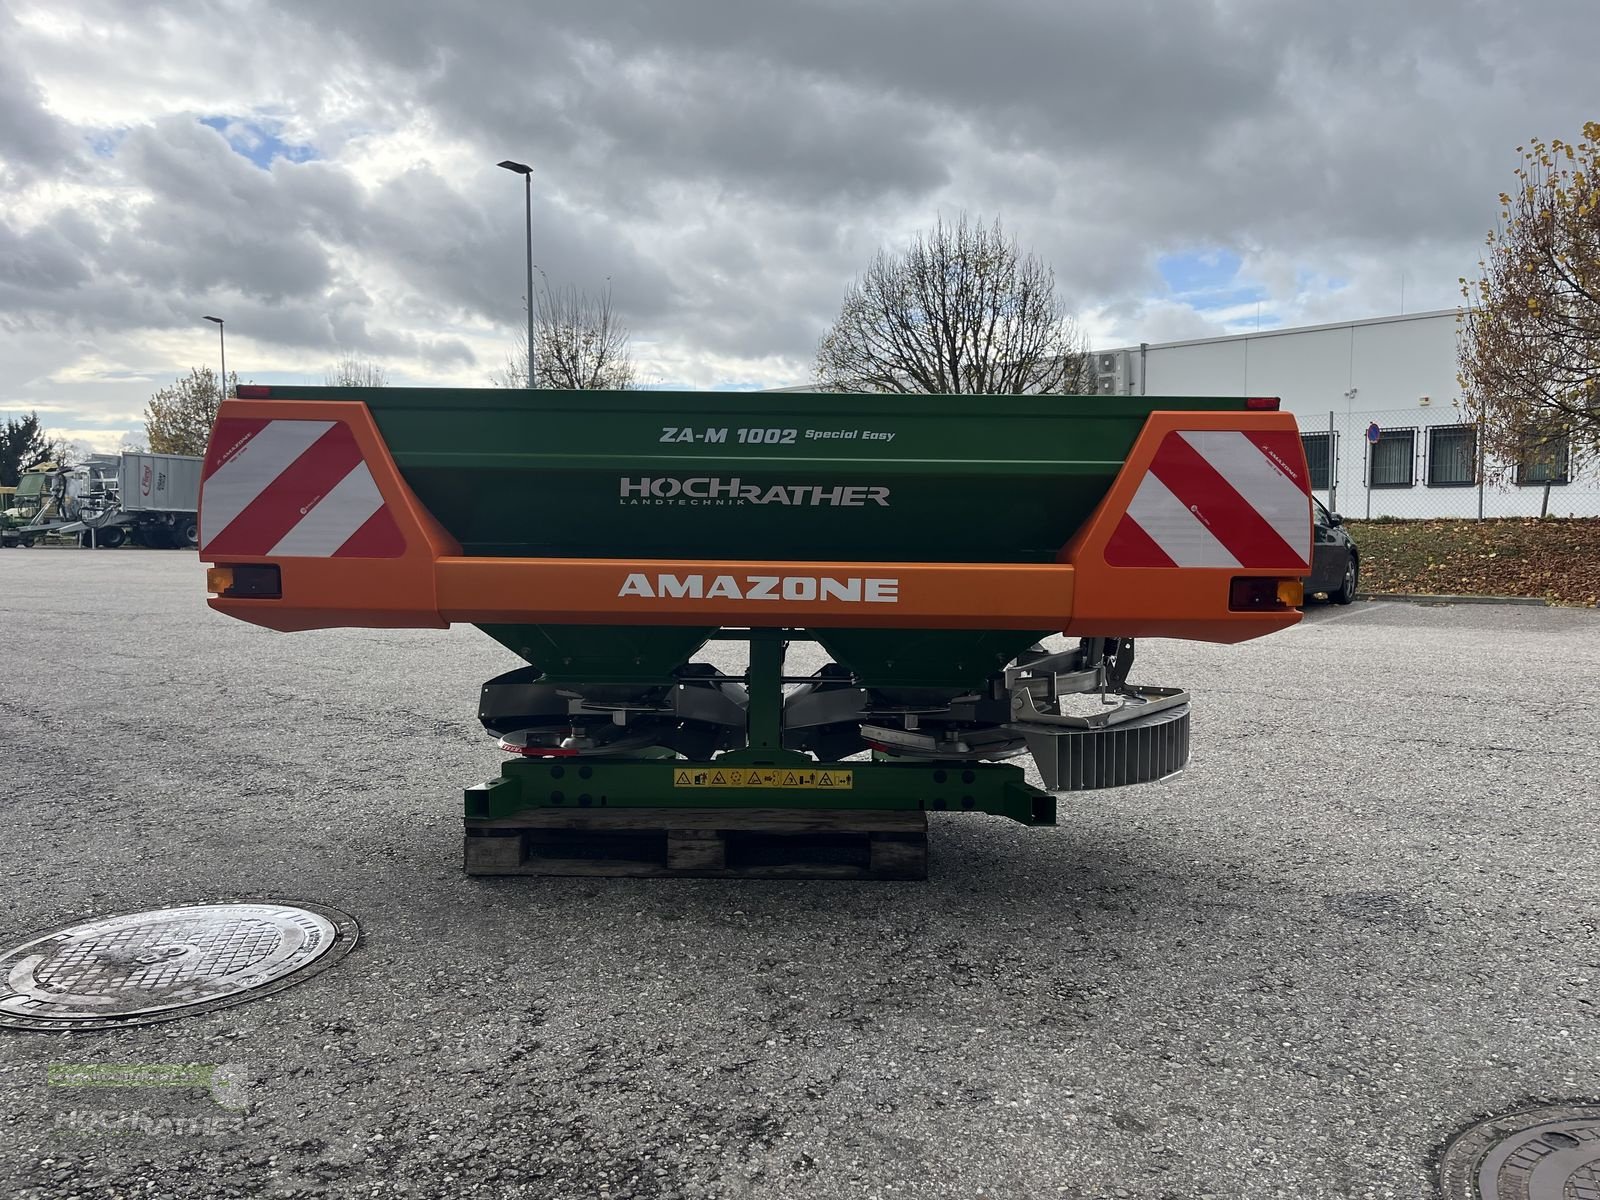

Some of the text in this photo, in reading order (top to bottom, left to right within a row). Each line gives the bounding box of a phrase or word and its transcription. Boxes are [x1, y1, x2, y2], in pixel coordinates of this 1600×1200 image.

[659, 427, 896, 445] ZA-M 1002 Special Easy
[1268, 450, 1298, 479] AMAZONE
[620, 476, 890, 506] HOCHRATHER
[620, 498, 745, 506] LANDTECHNIK
[617, 573, 900, 603] AMAZONE
